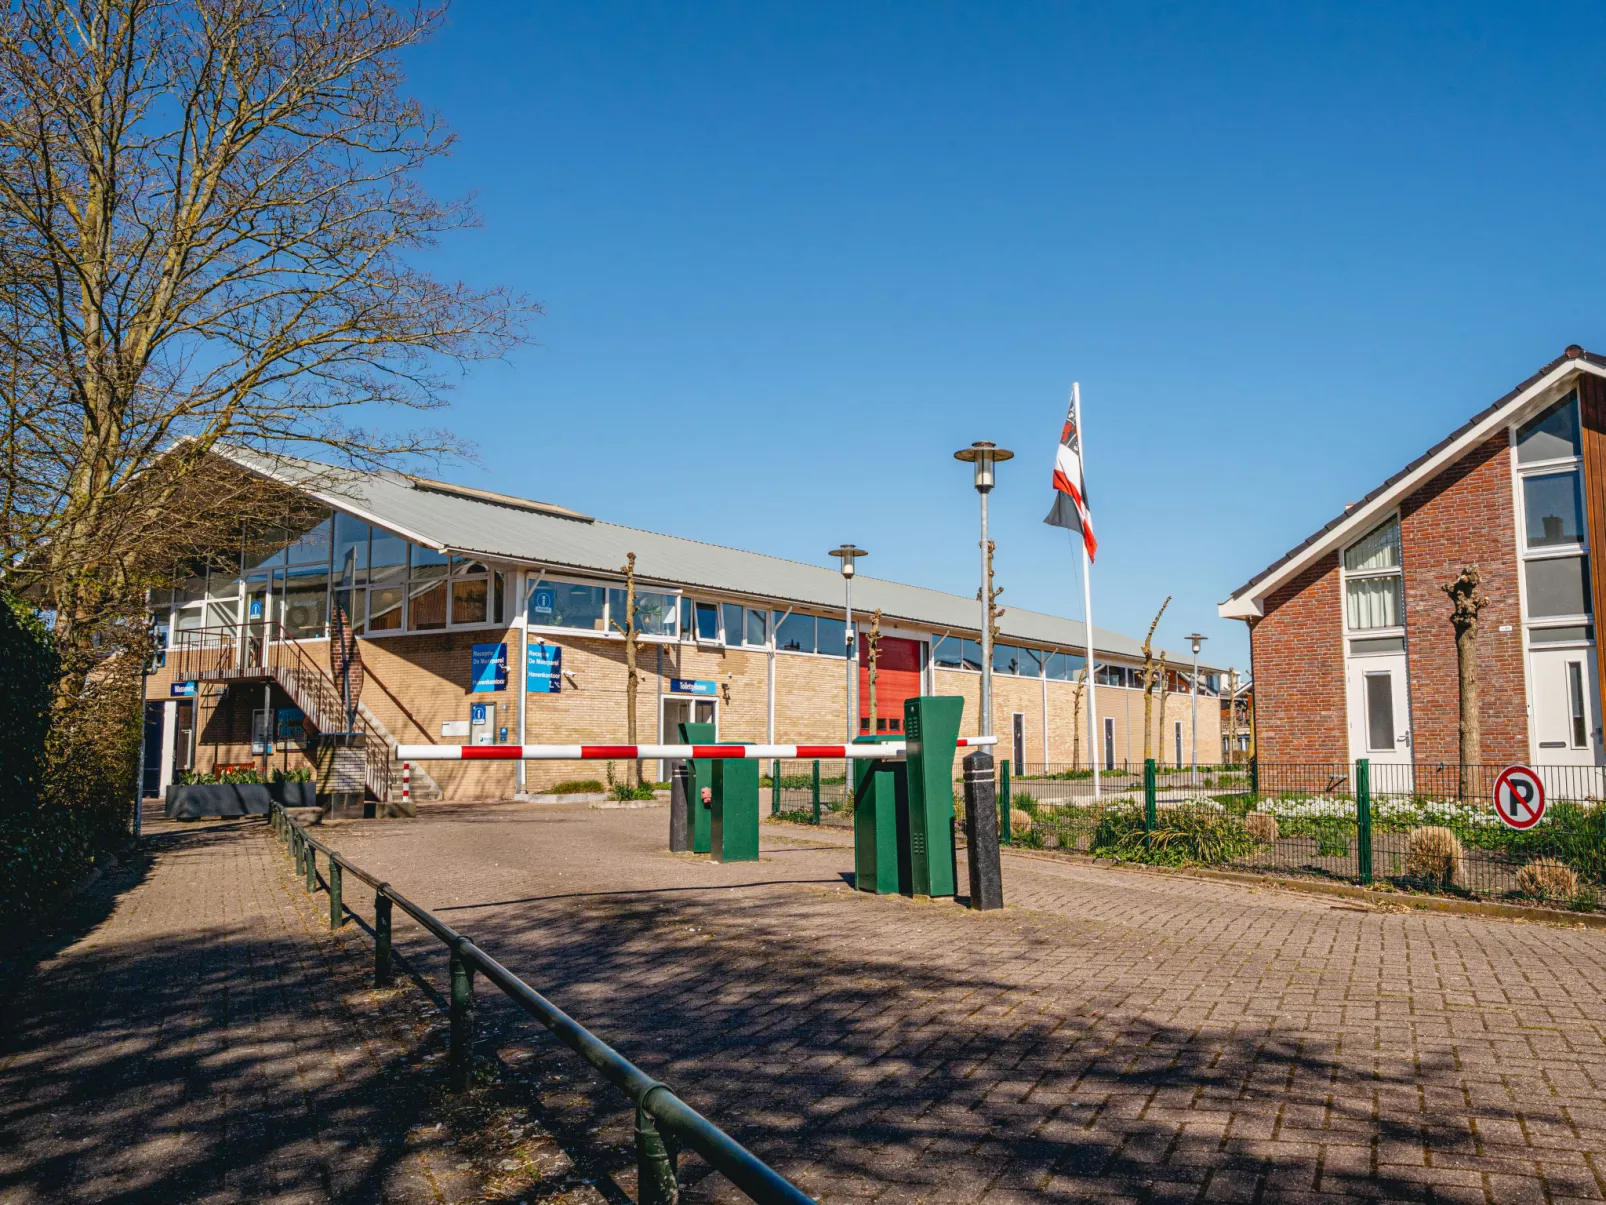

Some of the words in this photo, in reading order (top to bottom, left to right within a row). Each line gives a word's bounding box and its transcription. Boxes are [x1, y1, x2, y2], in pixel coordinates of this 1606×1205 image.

[528, 657, 536, 665] De
[528, 671, 561, 679] Havenkantoor
[1510, 778, 1534, 817] P
